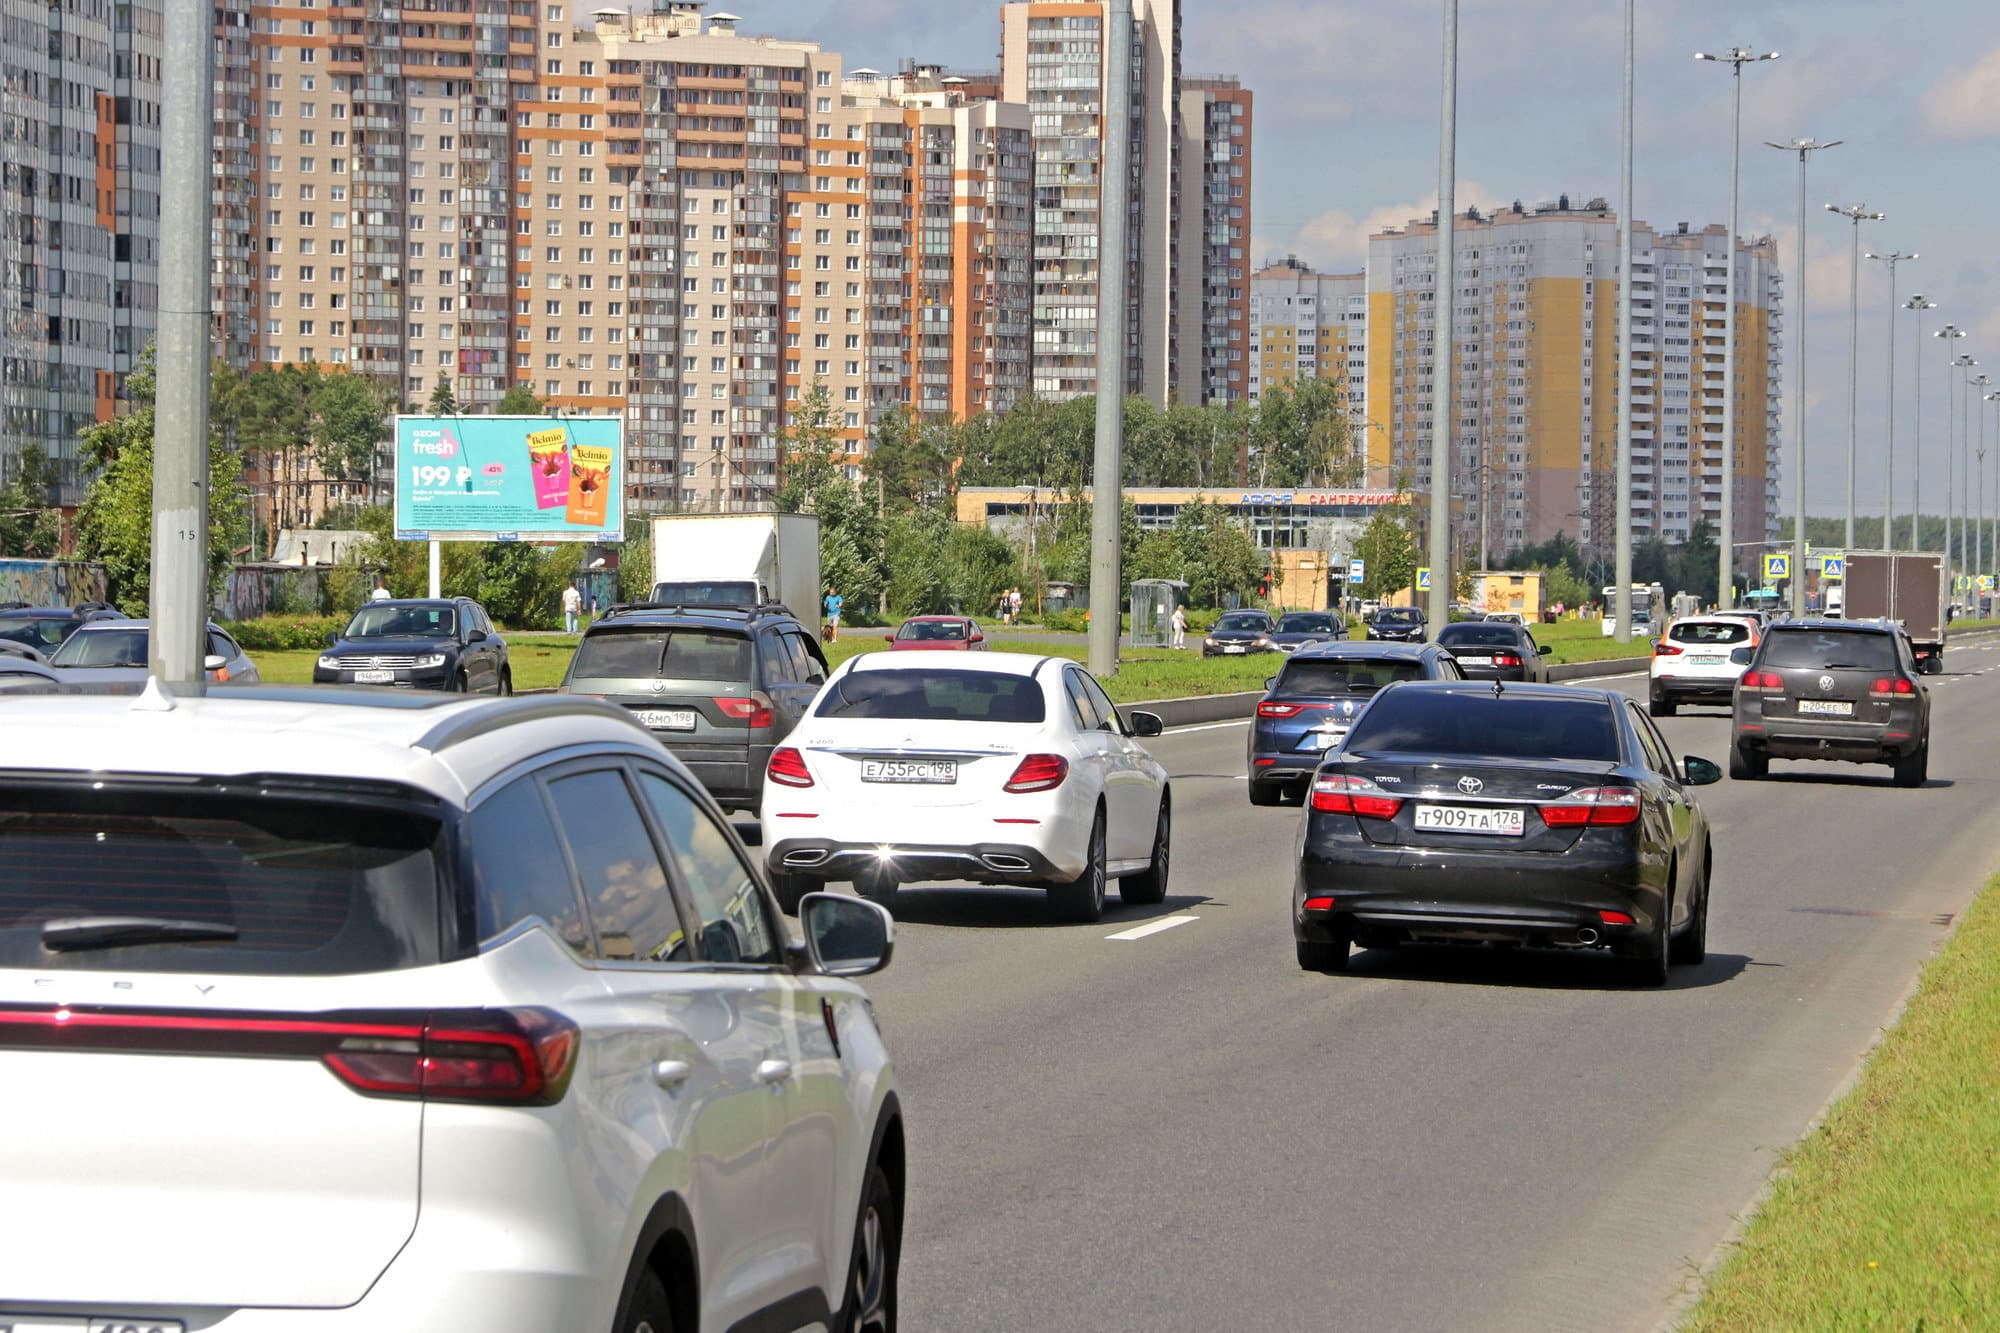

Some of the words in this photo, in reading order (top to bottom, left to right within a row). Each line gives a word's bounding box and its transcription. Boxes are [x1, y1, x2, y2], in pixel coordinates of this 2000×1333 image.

[532, 434, 562, 445] Belmio
[413, 439, 453, 454] fresh
[577, 449, 608, 460] Belmio
[412, 466, 450, 486] 199
[1241, 493, 1293, 505] АФОНЯ
[179, 530, 195, 540] 15
[673, 712, 692, 722] 198
[866, 761, 926, 776] Е755РС
[930, 762, 952, 776] 198
[1421, 809, 1489, 828] Т909ТА
[1494, 811, 1519, 825] 178
